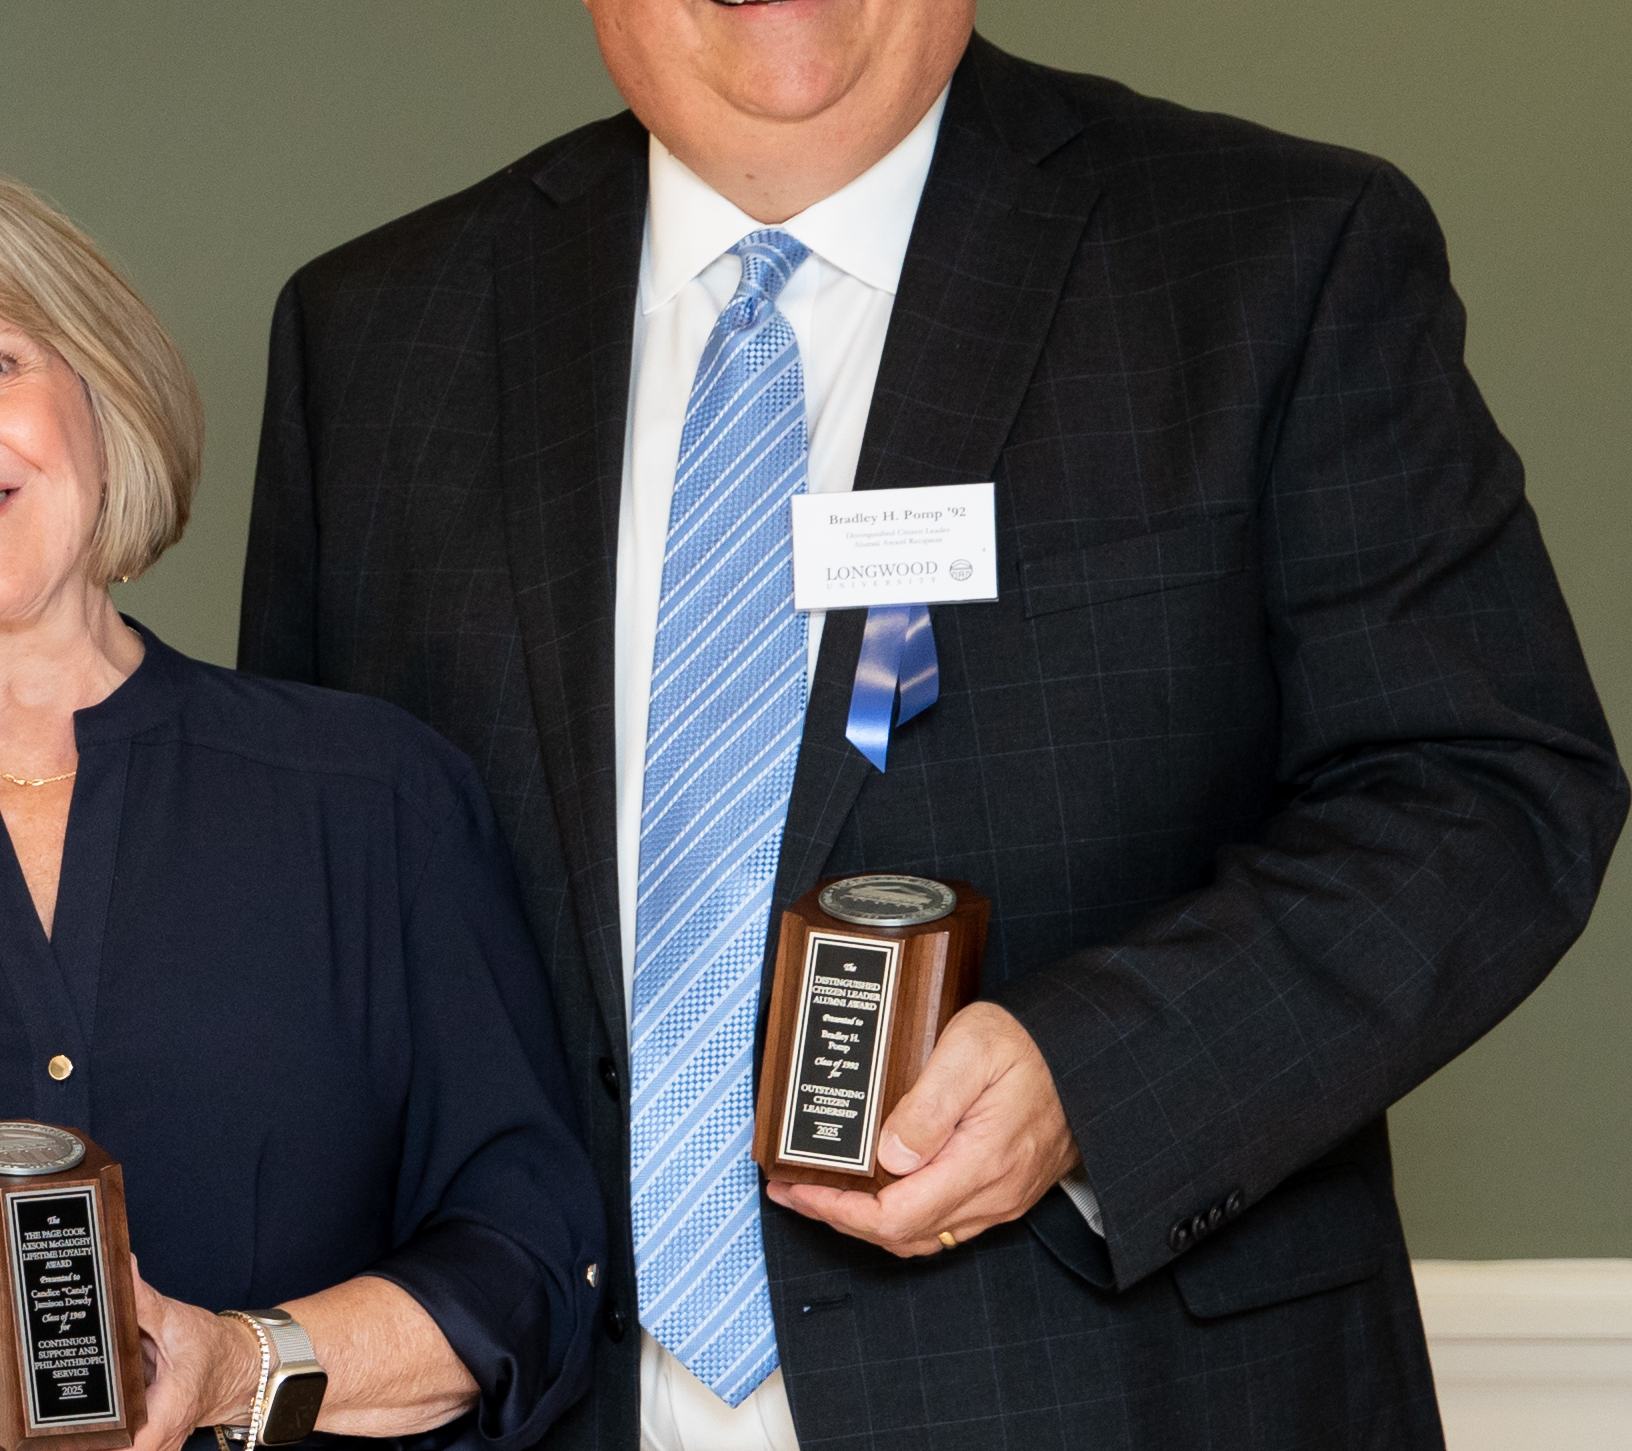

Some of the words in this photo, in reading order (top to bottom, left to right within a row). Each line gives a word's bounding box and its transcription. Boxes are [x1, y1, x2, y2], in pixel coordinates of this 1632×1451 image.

[829, 513, 878, 525] Bradley
[883, 511, 899, 521] H.
[904, 510, 943, 522] Pomp
[947, 507, 967, 517] '92
[826, 561, 938, 581] LONGWOOD
[827, 577, 936, 590] UNIVERSITY
[815, 975, 881, 991] DISTINGUISHED
[812, 985, 846, 998] CITIZEN
[847, 989, 881, 1002] LEADER
[813, 995, 846, 1007] ALUMNI
[847, 1000, 877, 1011] AWARD
[821, 1029, 850, 1043] Bradley
[814, 1057, 833, 1067] Class
[833, 1059, 844, 1072] of
[827, 1069, 842, 1079] for
[801, 1084, 865, 1100] OUTSTANDING
[813, 1095, 850, 1108] CITIZEN
[802, 1103, 858, 1119] LEADERSHIP
[816, 1125, 839, 1137] 2025
[47, 1215, 60, 1225] The
[24, 1231, 41, 1241] THE
[42, 1229, 62, 1239] PAGE
[62, 1227, 86, 1237] COOK
[22, 1241, 48, 1251] AXSON
[49, 1237, 92, 1249] McGAUGHY
[22, 1250, 58, 1261] LIFETIME
[58, 1247, 93, 1258] LOYALTY
[44, 1259, 72, 1269] AWARD
[73, 1273, 81, 1281] to
[31, 1288, 61, 1299] Candice
[34, 1299, 64, 1311] Jamison
[65, 1295, 92, 1307] Dowdy
[41, 1313, 60, 1323] Class
[60, 1311, 70, 1324] of
[69, 1311, 86, 1320] 1969
[58, 1323, 71, 1334] for
[38, 1336, 97, 1349] CONTINUOUS
[38, 1348, 77, 1359] SUPPORT
[78, 1346, 98, 1356] AND
[33, 1355, 105, 1370] PHILANTHROPIC
[52, 1367, 89, 1379] SERVICE
[62, 1384, 84, 1396] 2025
